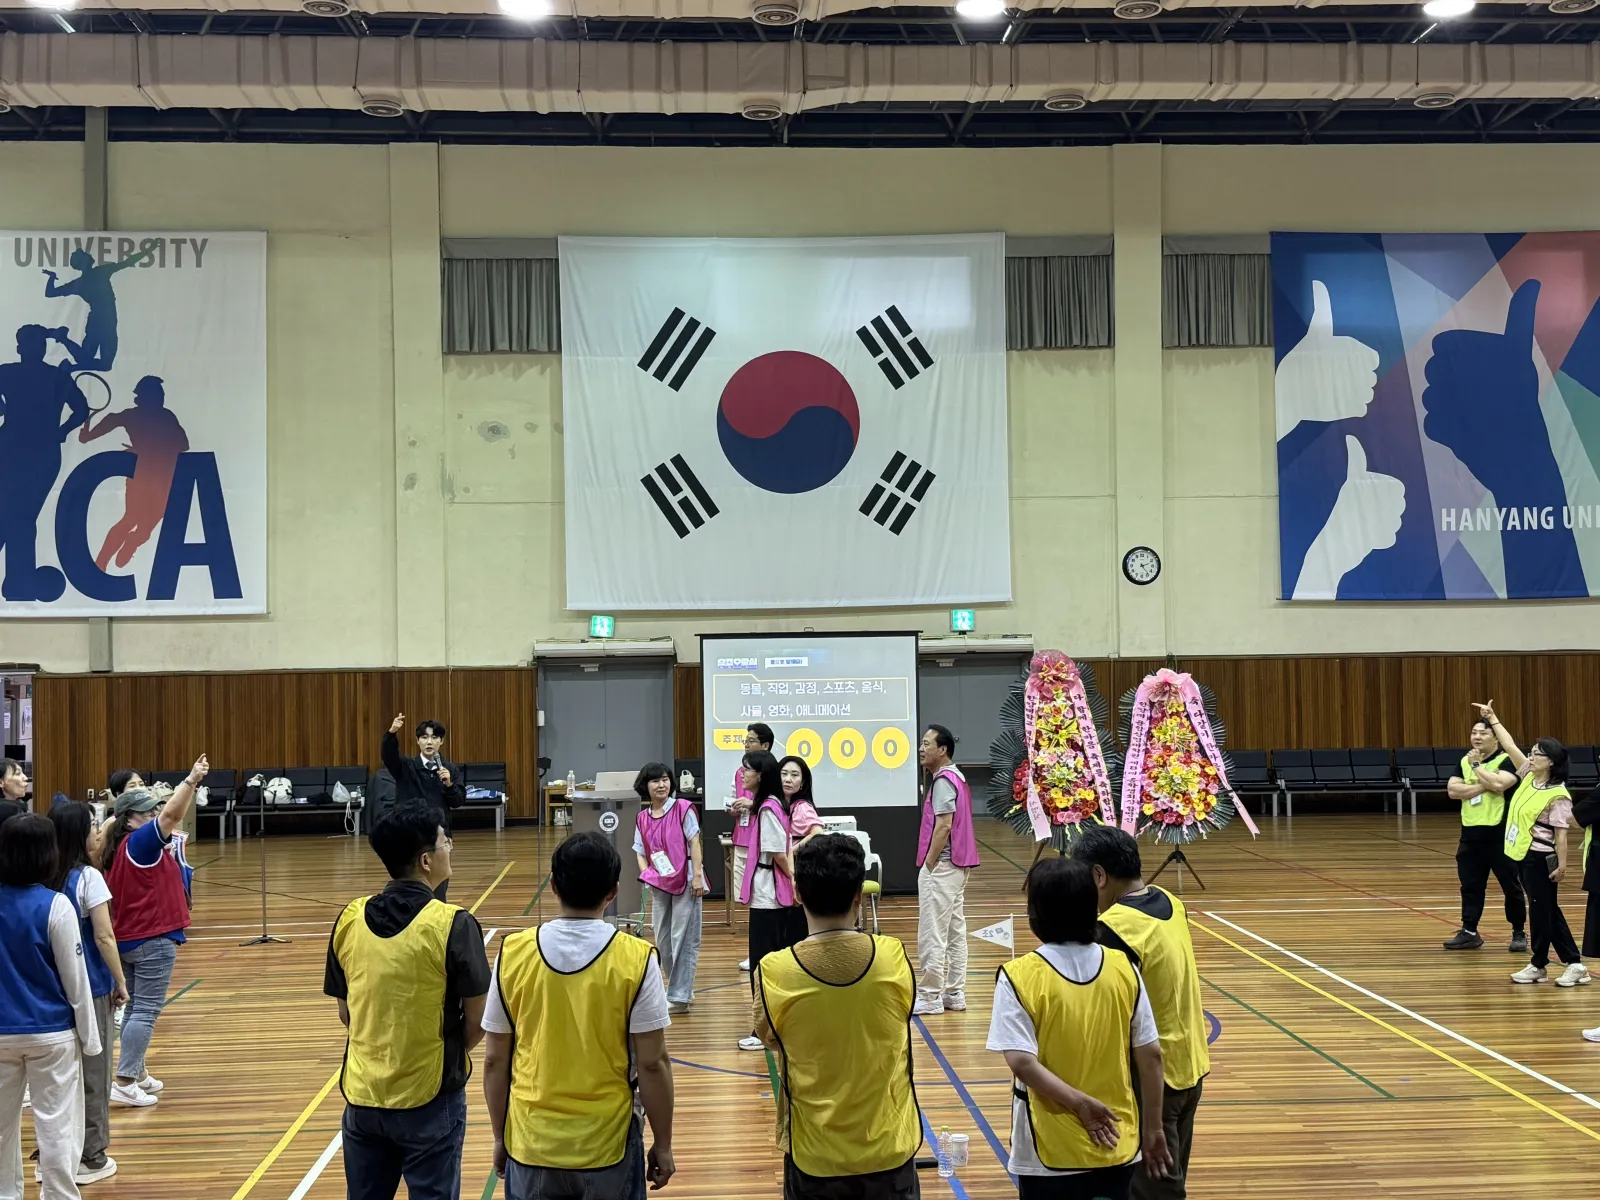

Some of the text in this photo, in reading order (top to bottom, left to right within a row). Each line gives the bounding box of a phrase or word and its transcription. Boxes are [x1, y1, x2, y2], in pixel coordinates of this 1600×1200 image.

[14, 236, 209, 269] UNIVERSITY
[1441, 506, 1555, 532] HANYANG
[740, 680, 887, 696] 동물, 직업, 감정, 스포츠, 음식,
[740, 703, 851, 718] 사물, 영화, 애니메이션
